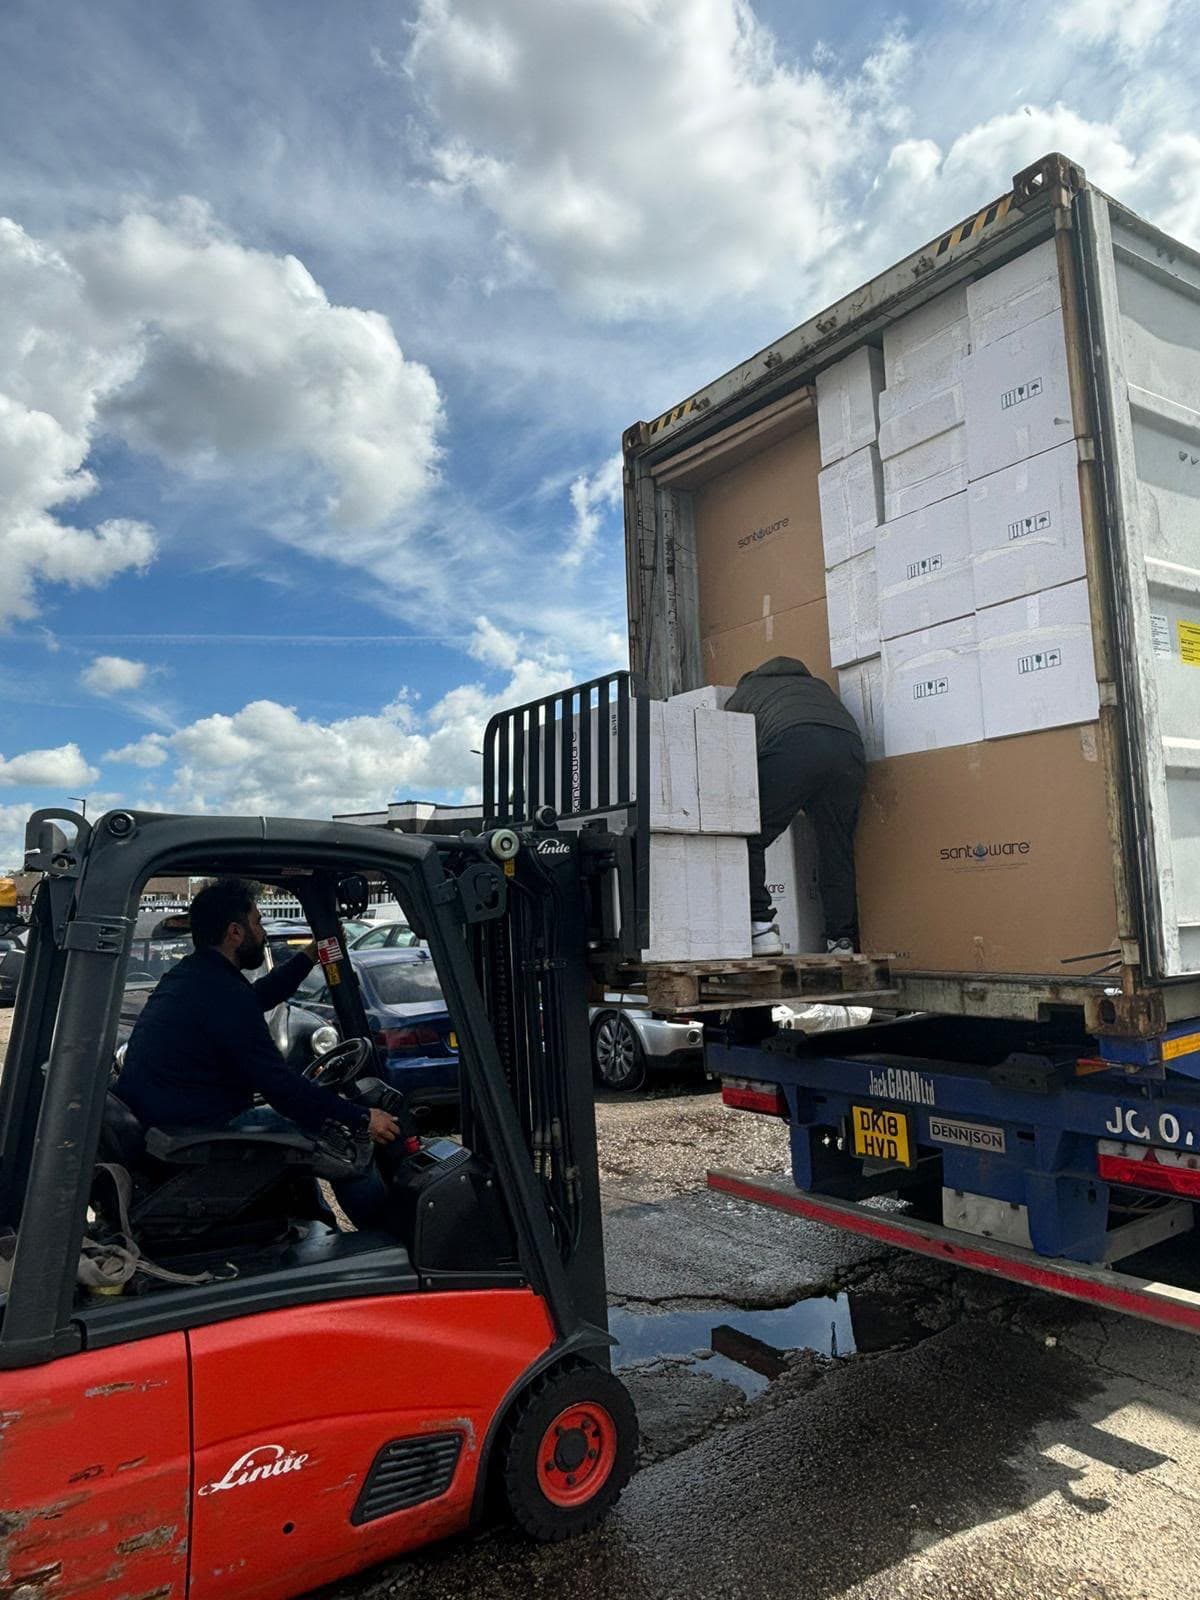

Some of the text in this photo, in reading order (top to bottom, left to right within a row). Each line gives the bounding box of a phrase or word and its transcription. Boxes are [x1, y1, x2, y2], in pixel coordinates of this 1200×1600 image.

[537, 838, 570, 854] Linde
[940, 842, 1030, 860] santoware
[887, 1067, 921, 1104] GARN
[860, 1110, 899, 1137] DK18
[931, 1123, 1003, 1147] DENNISON
[863, 1134, 898, 1160] HVD
[198, 1444, 309, 1496] Linde
